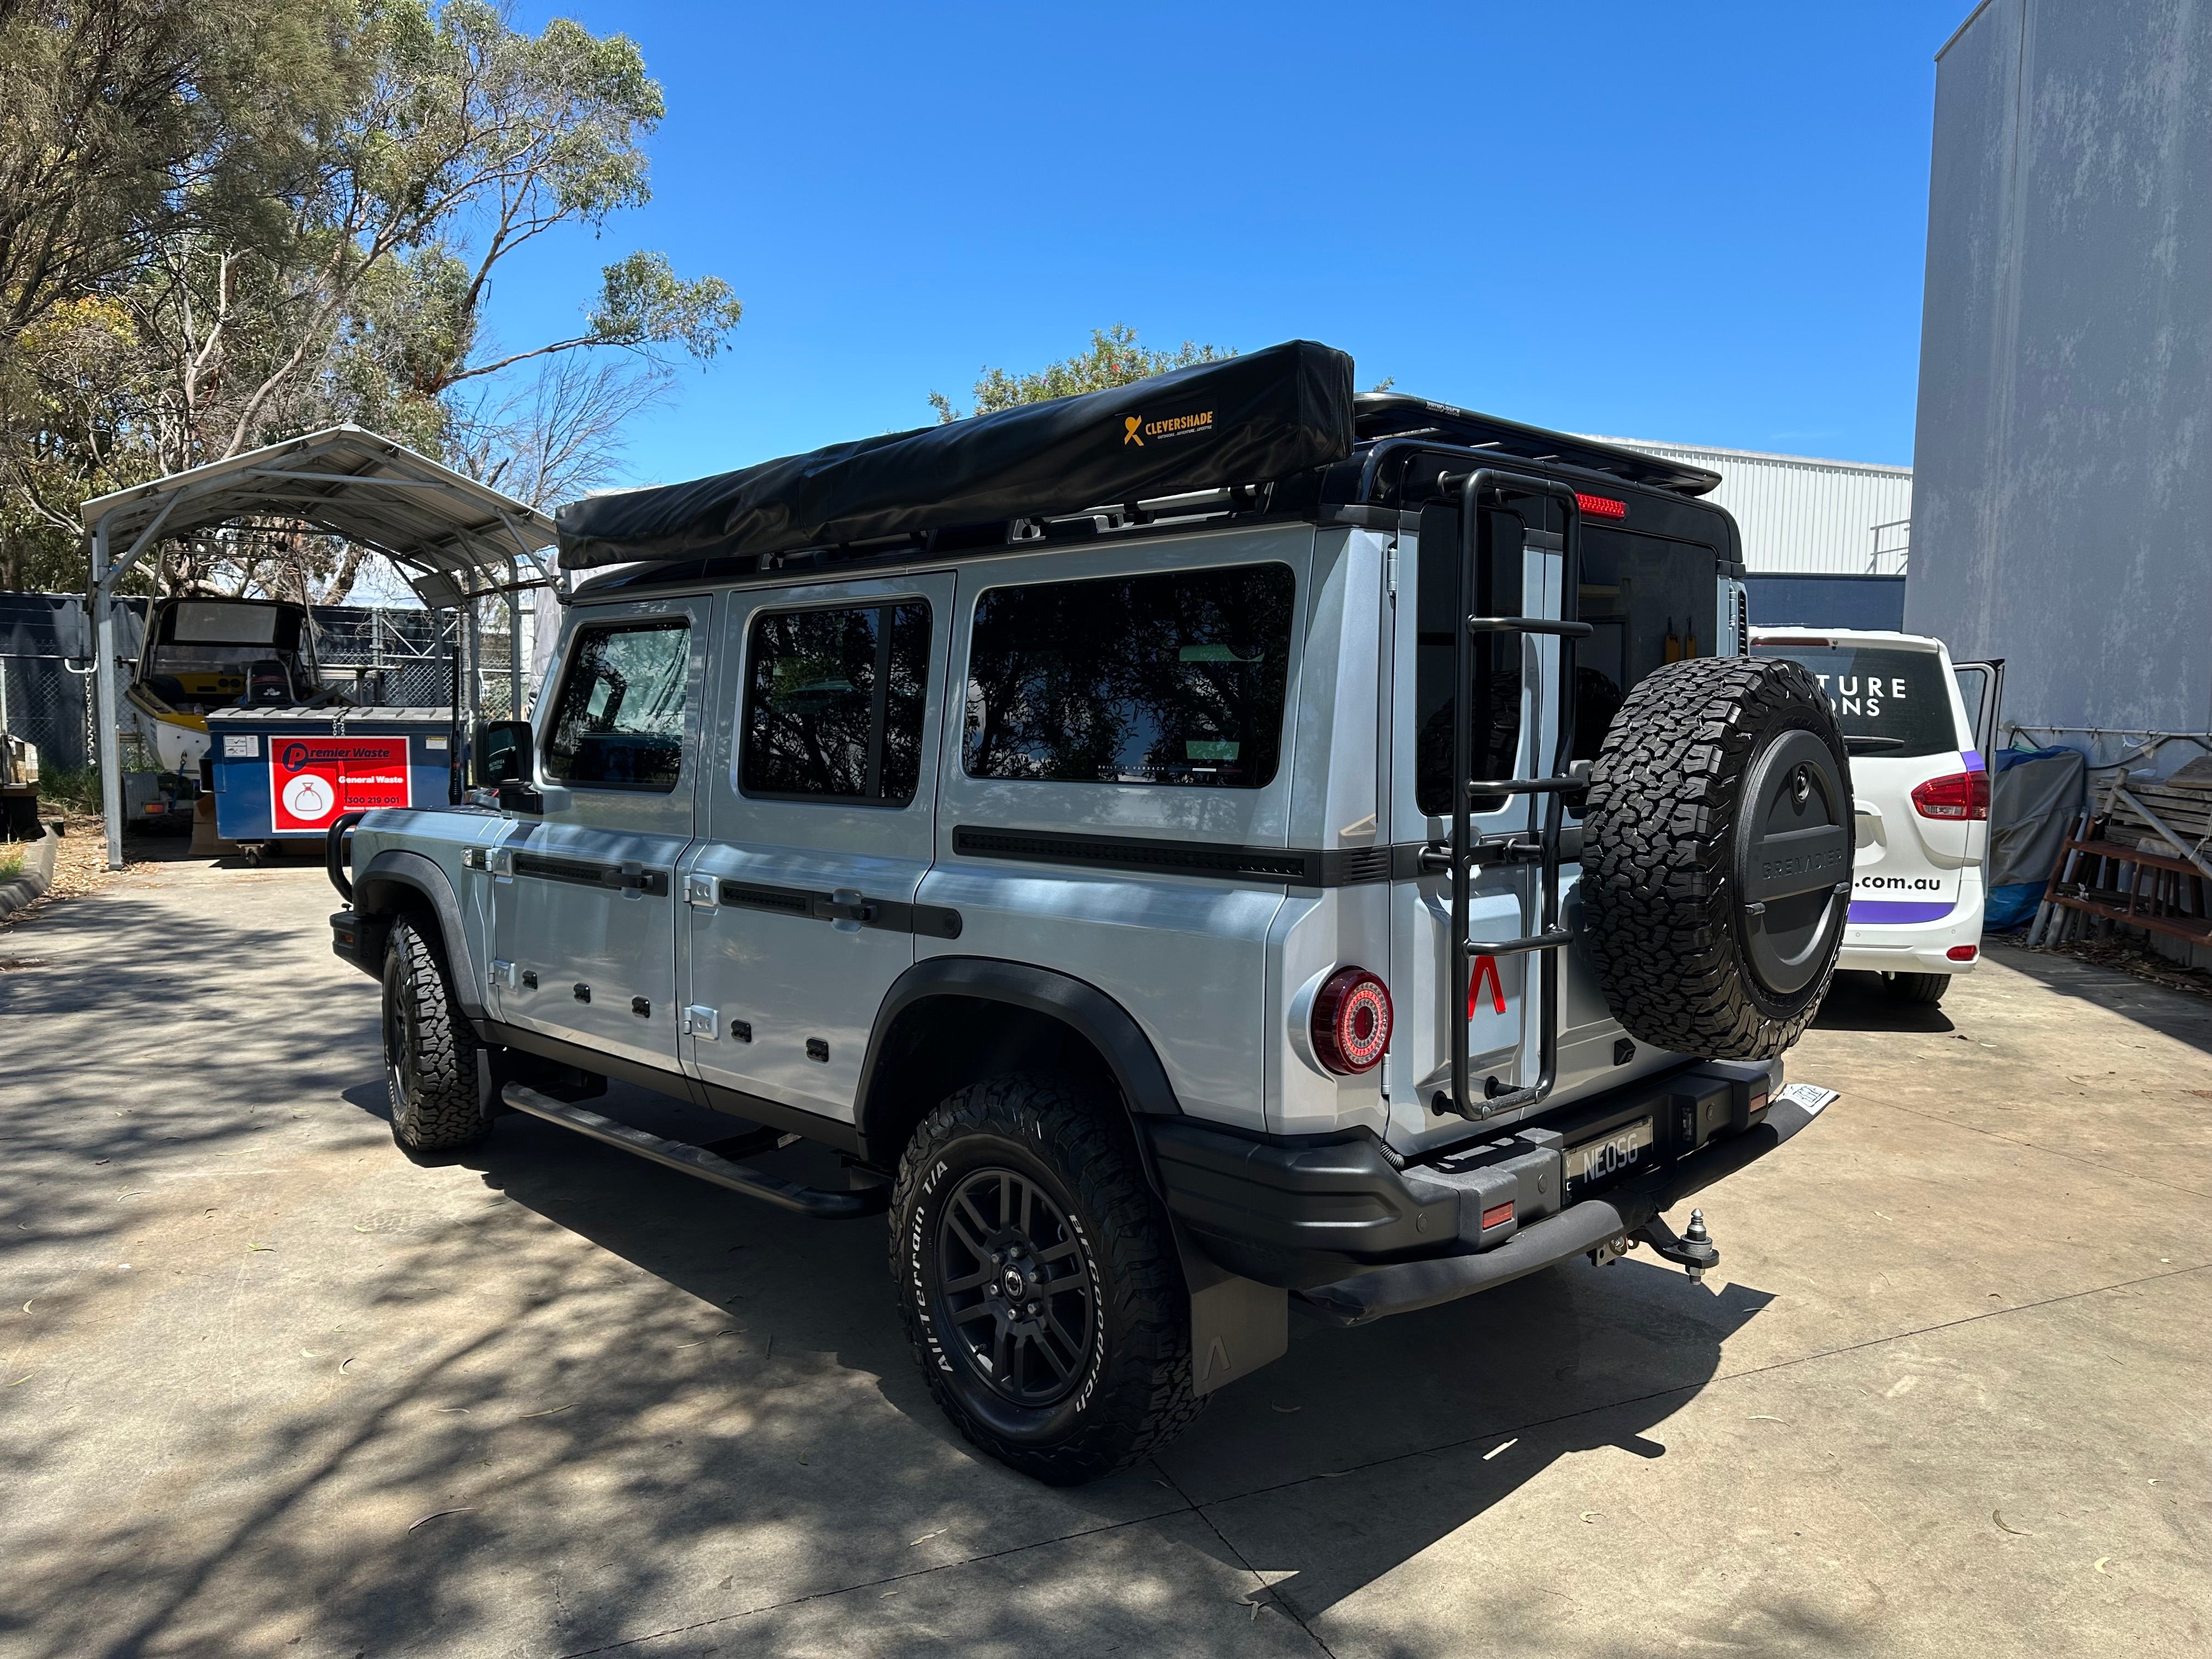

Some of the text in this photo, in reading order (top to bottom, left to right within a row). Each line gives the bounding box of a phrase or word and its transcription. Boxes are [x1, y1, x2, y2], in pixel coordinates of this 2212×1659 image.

[1146, 411, 1213, 435] CLEVERSHADE
[283, 743, 390, 772] Premier Waste
[1763, 848, 1842, 880] GRENADIER
[922, 1161, 948, 1195] T/A
[1069, 1214, 1104, 1413] BFGoodrich
